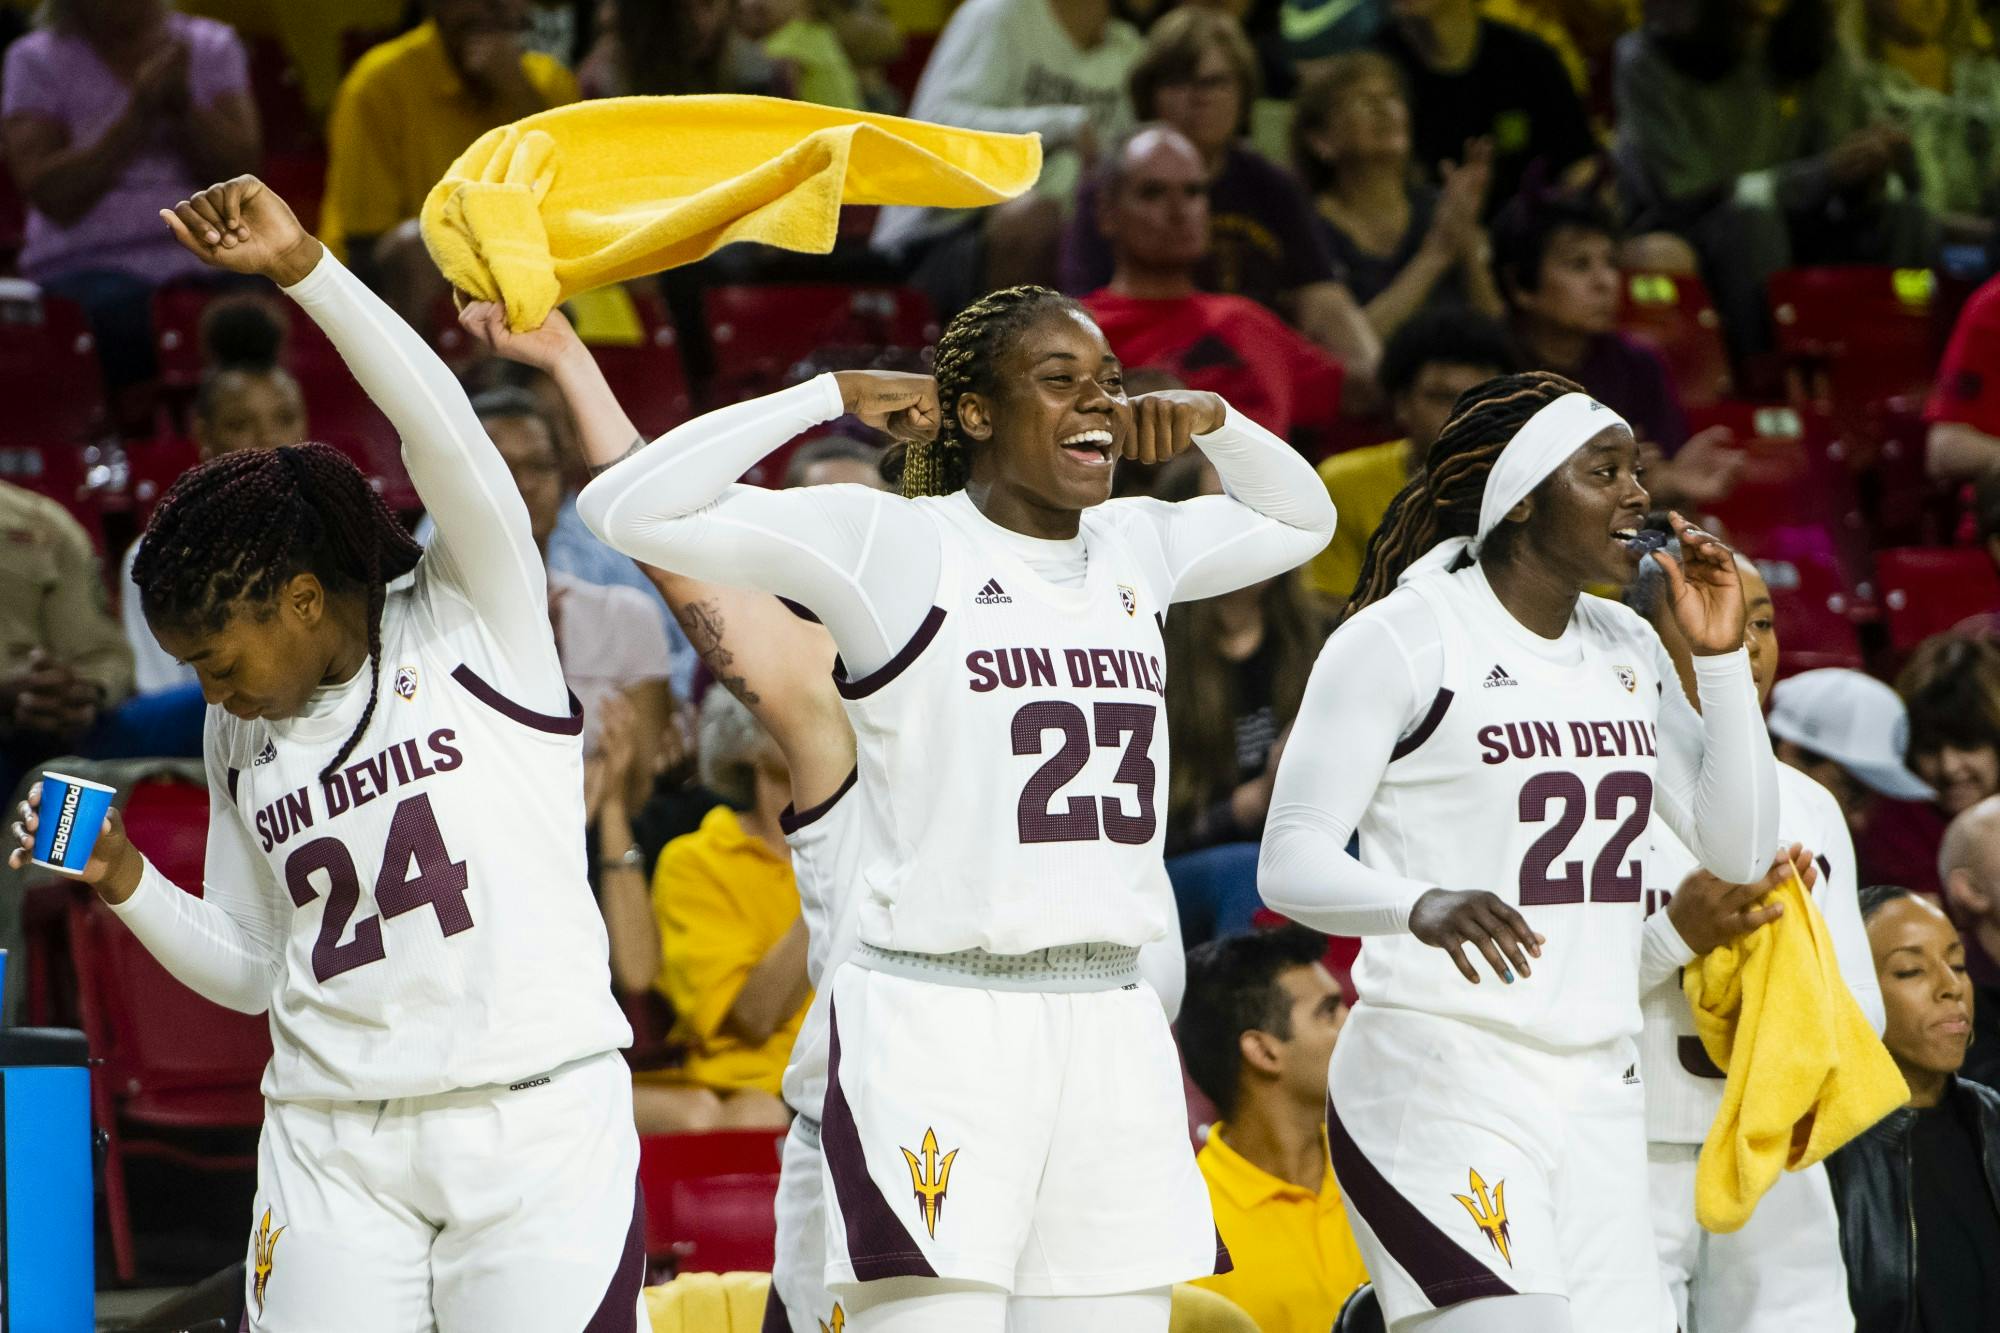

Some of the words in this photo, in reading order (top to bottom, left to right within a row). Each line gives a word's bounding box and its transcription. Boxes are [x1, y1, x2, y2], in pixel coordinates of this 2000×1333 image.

[975, 594, 1013, 605] adidas
[966, 647, 1058, 693] SUN
[1062, 648, 1163, 698] DEVILS
[1483, 678, 1518, 689] adidas
[1010, 701, 1156, 844] 23
[1478, 721, 1562, 765] SUN
[1568, 720, 1658, 758] DEVIL
[51, 784, 81, 861] POWERADE
[255, 787, 314, 853] SUN
[322, 728, 464, 820] DEVILS
[1518, 770, 1653, 906] 22
[285, 792, 474, 984] 24
